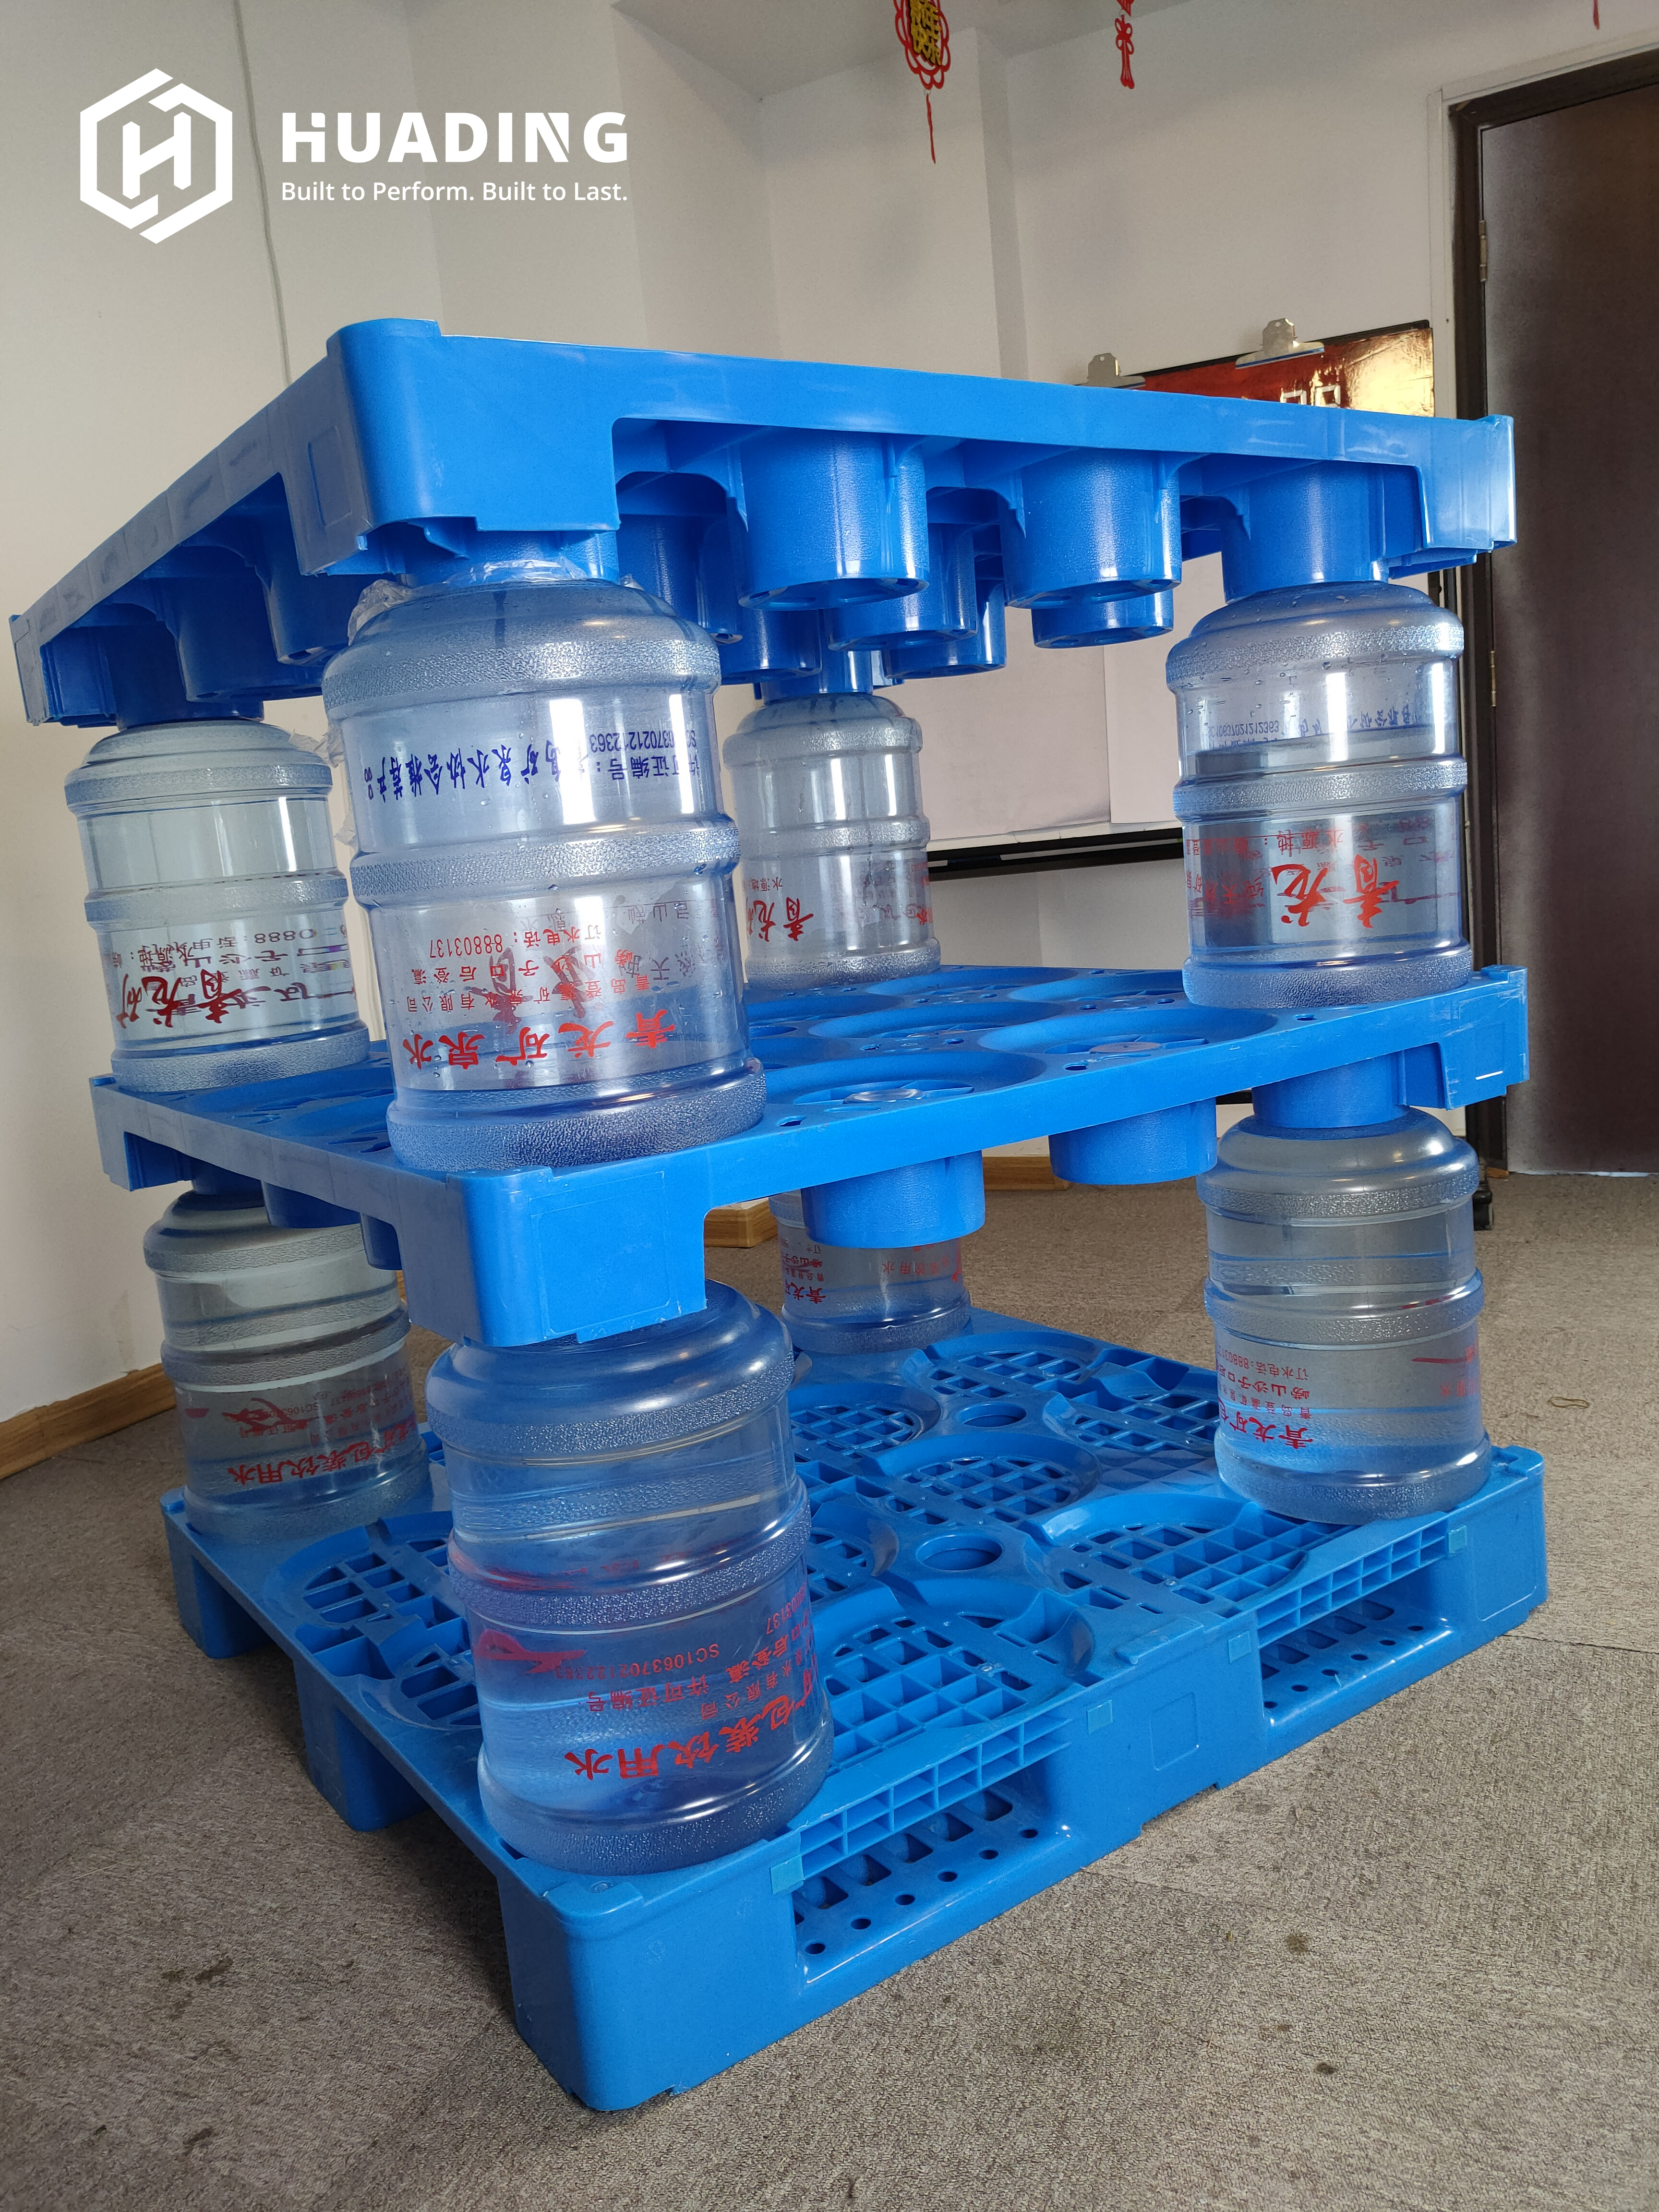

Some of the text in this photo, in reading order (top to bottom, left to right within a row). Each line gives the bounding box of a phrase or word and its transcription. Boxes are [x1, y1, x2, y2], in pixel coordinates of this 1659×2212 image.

[363, 740, 588, 803] 岛矿泉水协会推荐产品
[591, 730, 697, 753] SC637021212363
[403, 1010, 675, 1070] 青龙矿泉水
[1217, 1363, 1310, 1400] 崂山沙子口后
[564, 1655, 818, 1780] 矿包装饮用水
